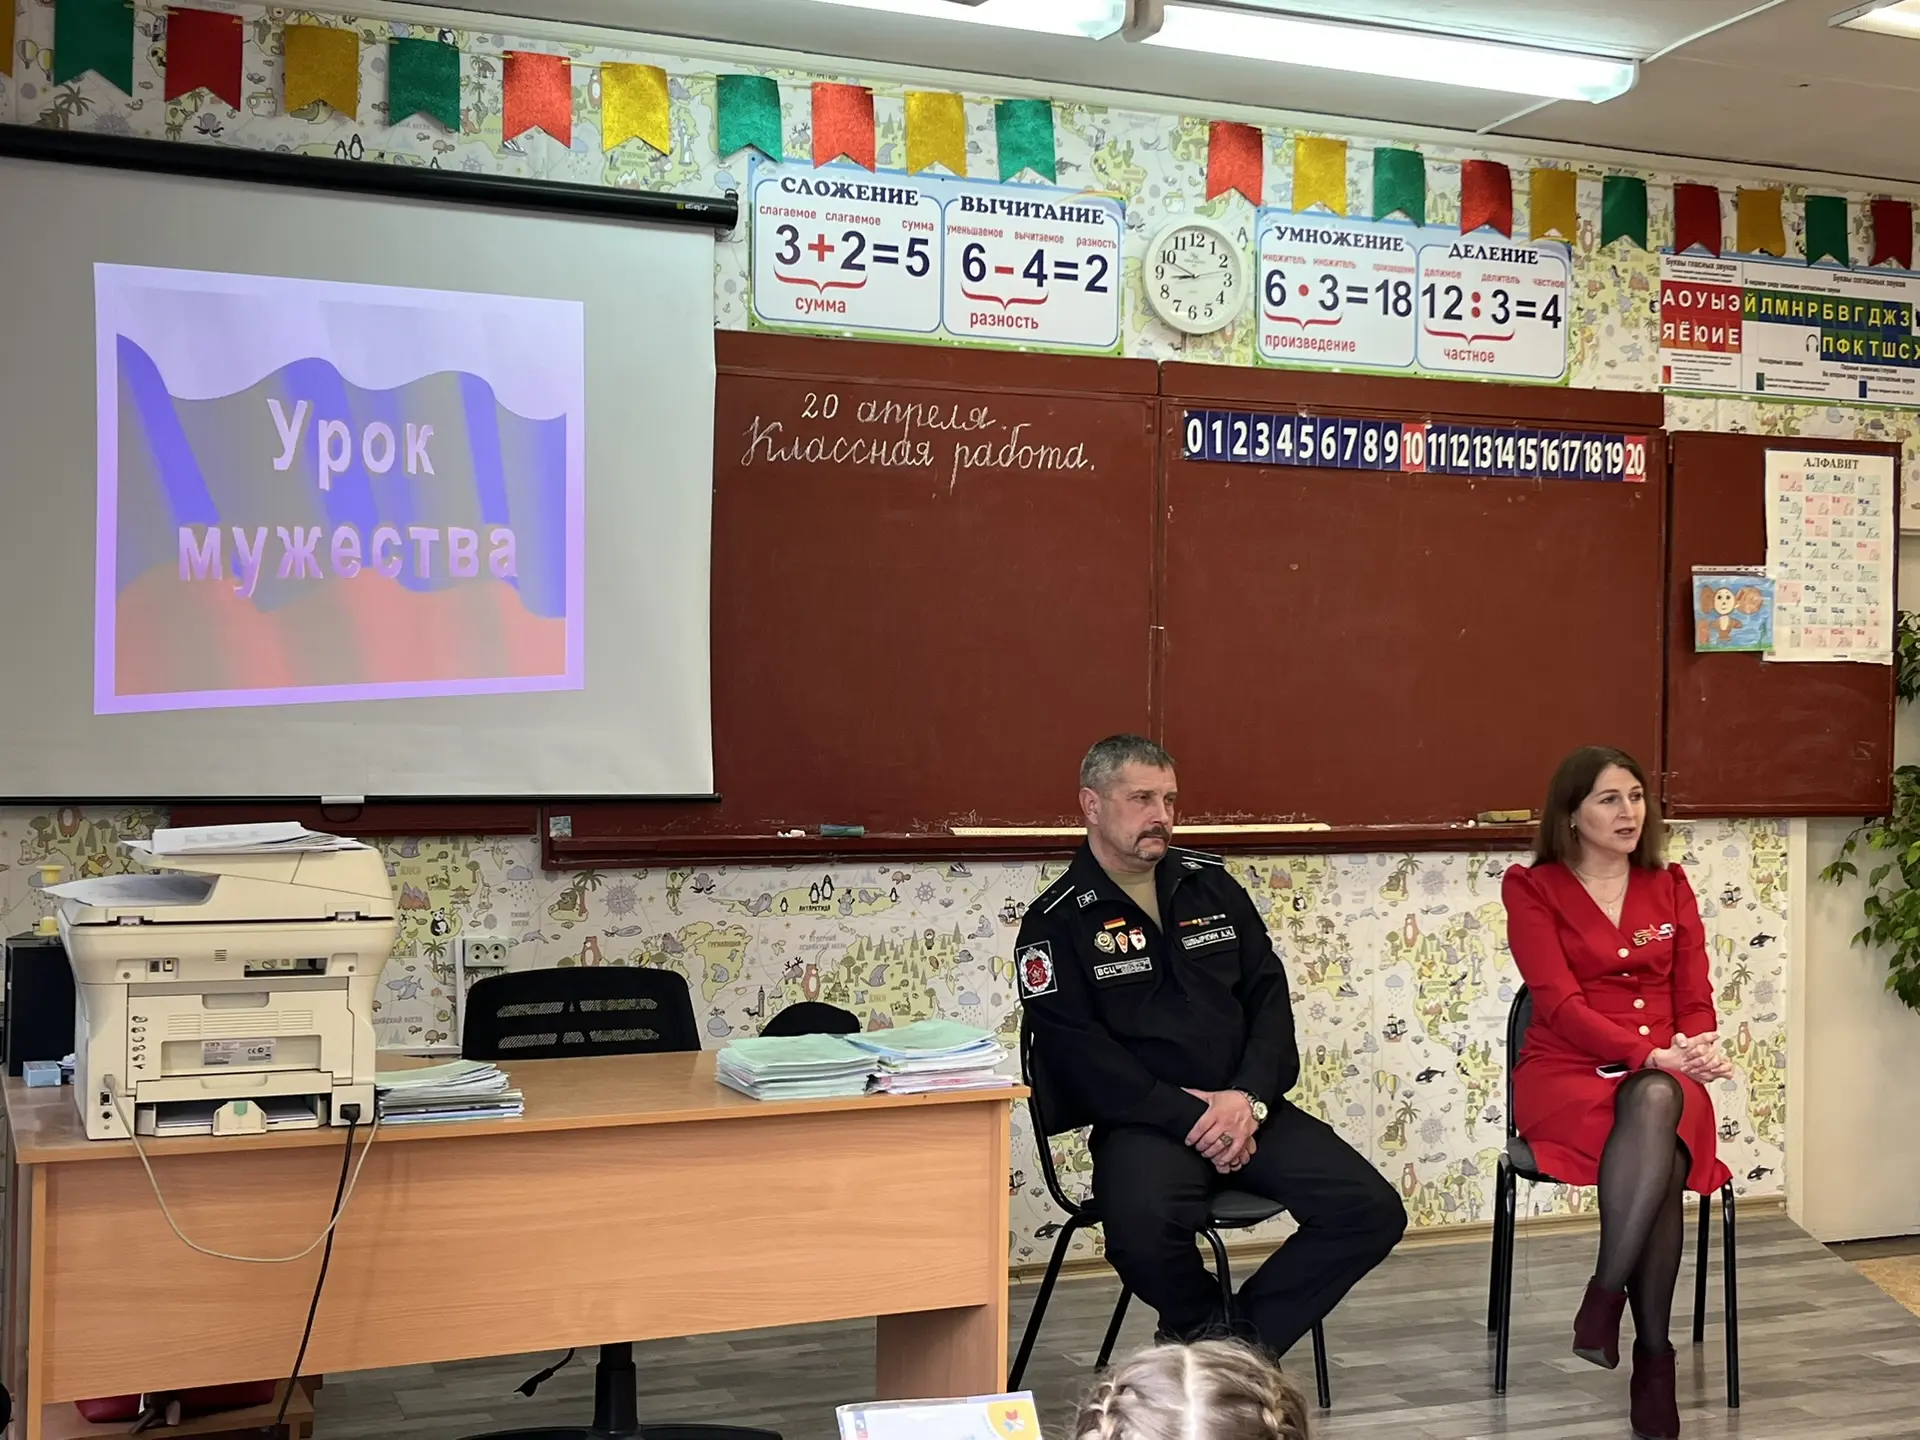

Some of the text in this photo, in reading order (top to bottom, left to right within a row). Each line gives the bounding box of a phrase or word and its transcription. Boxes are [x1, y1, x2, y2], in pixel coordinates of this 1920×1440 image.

[780, 176, 919, 207] СЛОЖЕНИЕ
[759, 205, 934, 232] слагаемое слагаемое сумма
[960, 195, 1106, 226] ВЫЧИТАНИЕ
[946, 223, 1117, 250] уменьшаемое вычитаемое разность
[1174, 236, 1187, 252] 11
[1189, 232, 1205, 248] 12
[1275, 226, 1405, 253] УМНОЖЕНИЕ
[1210, 241, 1216, 255] 1
[1448, 243, 1539, 265] ДЕЛЕНИЕ
[1161, 249, 1177, 265] 10
[1218, 253, 1229, 269] 2
[1263, 253, 1306, 266] множитель
[1313, 257, 1357, 270] множитель
[1665, 257, 1686, 267] Буквы
[1688, 260, 1714, 269] гласных
[1155, 265, 1165, 280] 9
[1223, 272, 1233, 288] 3
[1481, 272, 1520, 286] делитель
[1532, 277, 1565, 289] частное
[1833, 273, 1906, 289] Буквы согласных звуков
[1160, 284, 1170, 300] 8
[1215, 290, 1225, 305] 4
[795, 297, 846, 315] сумма
[1173, 299, 1182, 312] 7
[1187, 304, 1198, 320] 6
[1204, 303, 1213, 318] 5
[970, 310, 1040, 331] разность
[1265, 333, 1356, 353] произведение
[1443, 348, 1496, 364] частное
[799, 392, 839, 420] 20
[266, 398, 436, 492] Урок
[1187, 418, 1646, 475] 0 1 2 3 4 5 6 7 8 9 10 11 12 13 14 15 16 17 18 19 20
[741, 415, 1096, 497] Классная работа.
[1803, 457, 1859, 470] АЛФАВИТ
[178, 525, 519, 599] мужества
